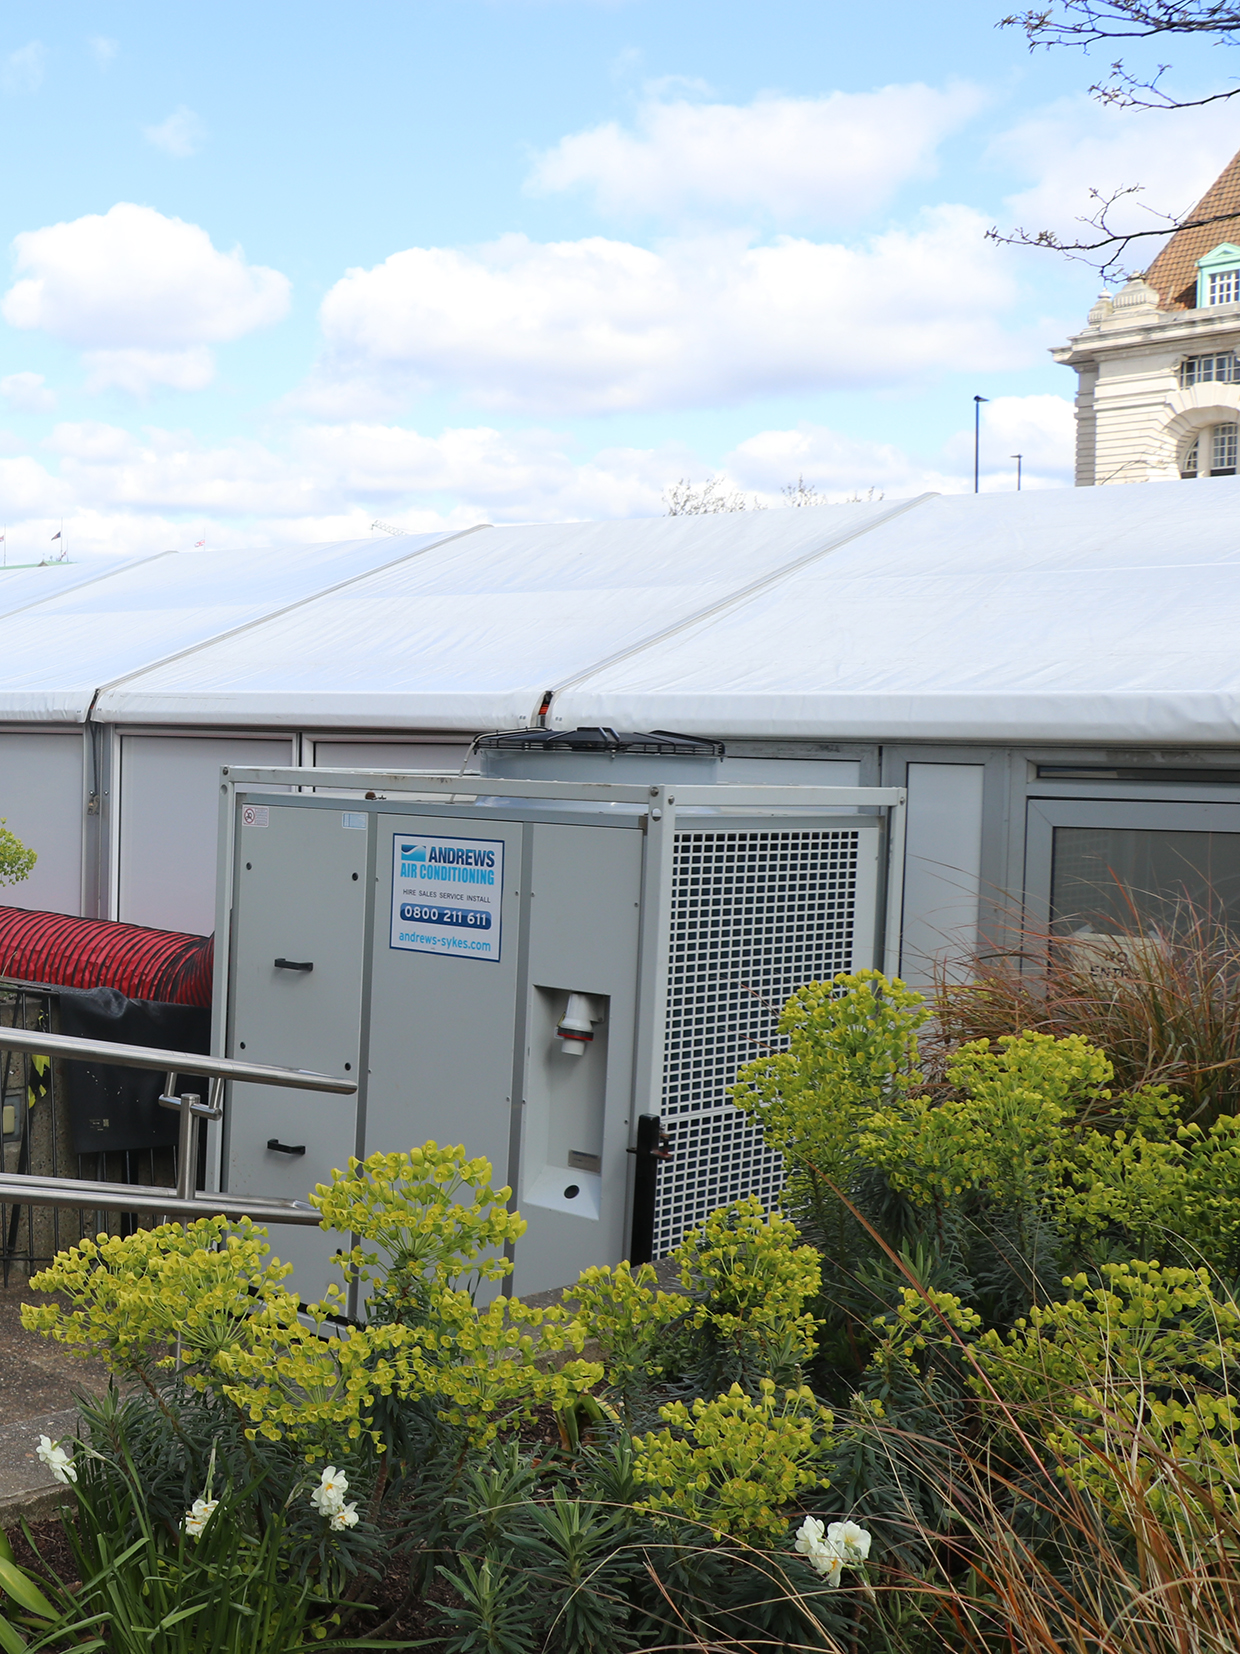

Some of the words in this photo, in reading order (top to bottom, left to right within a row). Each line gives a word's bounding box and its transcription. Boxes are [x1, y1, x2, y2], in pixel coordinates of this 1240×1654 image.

[428, 846, 495, 868] ANDREWS
[400, 862, 417, 878] AIR
[420, 864, 495, 885] CONDITIONING
[419, 890, 437, 898] SALES
[440, 892, 464, 901] SERVICE
[467, 895, 491, 903] INSTALL
[405, 905, 439, 920] 0800
[443, 910, 462, 923] 211
[467, 913, 486, 926] 611
[399, 931, 491, 951] andrews-sykes.com
